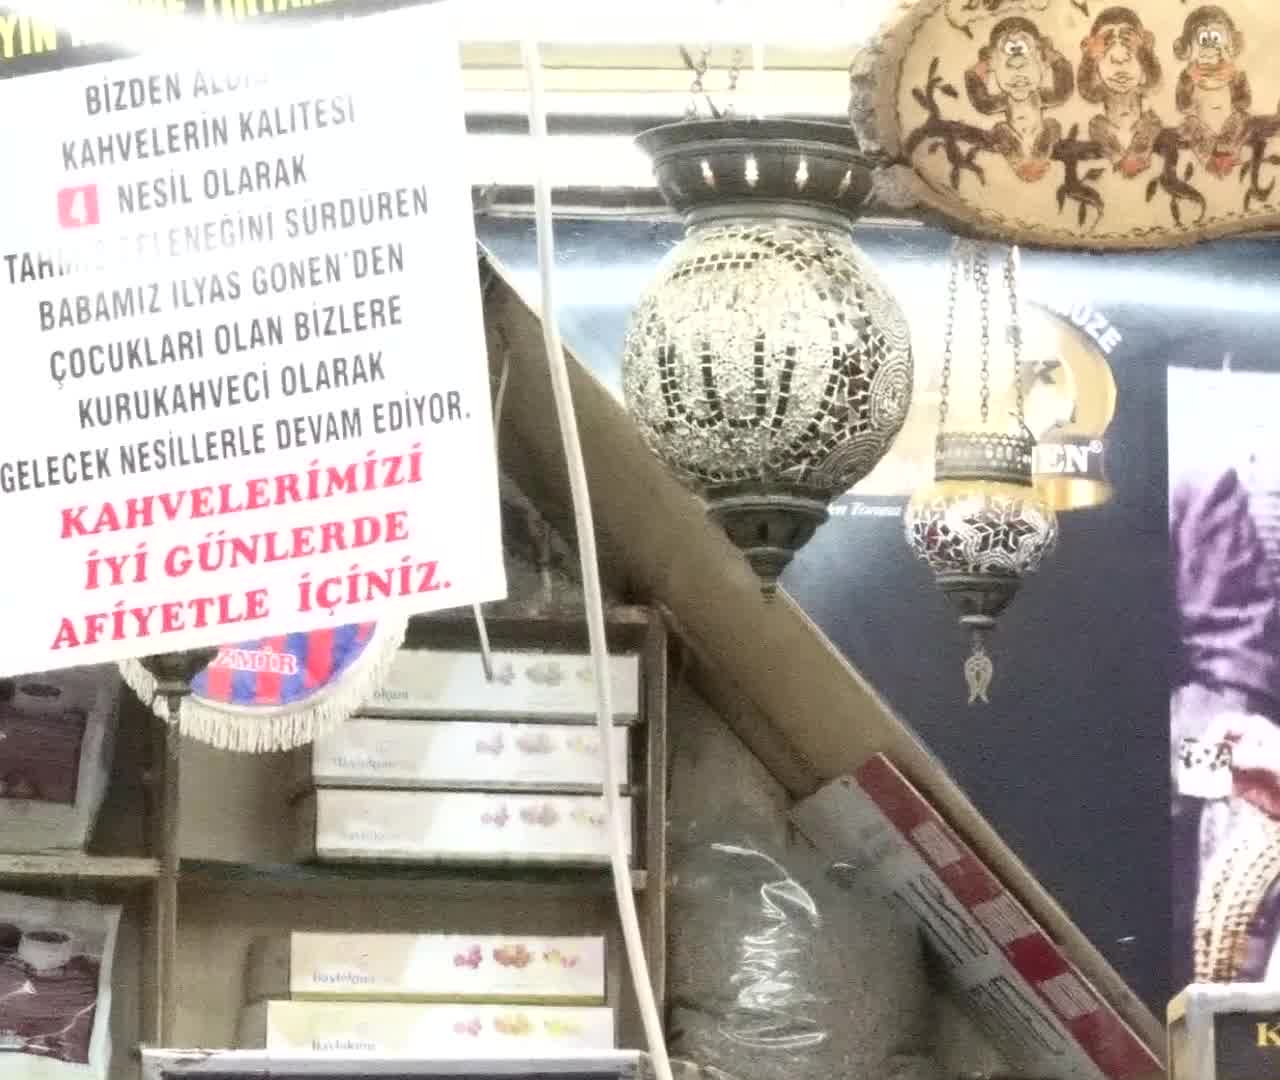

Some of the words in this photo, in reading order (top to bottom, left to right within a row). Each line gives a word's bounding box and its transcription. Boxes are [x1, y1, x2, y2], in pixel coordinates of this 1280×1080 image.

[85, 72, 181, 116] BİZDEN
[62, 112, 228, 172] KAHVELERİN
[117, 174, 192, 213] NESİL
[203, 155, 308, 200] OLARAK
[39, 283, 161, 331] BABAMIZ
[50, 328, 203, 390] ÇOCUKLARI
[215, 308, 283, 352] OLAN
[295, 294, 403, 342] BİZLERE
[78, 365, 271, 430] KURUKAHVECİ
[281, 351, 386, 397] OLARAK
[0, 452, 112, 494] GELECEK
[120, 424, 266, 475] NESİLLERLE
[277, 408, 363, 448] DEVAM
[372, 389, 471, 434] EDİYOR.
[59, 444, 425, 539] KAHVELERİMİZİ
[84, 548, 148, 590] İYİ
[164, 510, 411, 580] GÜNLERDE
[50, 587, 271, 650] AFİYETLE
[297, 559, 452, 618] İÇİNİZ.
